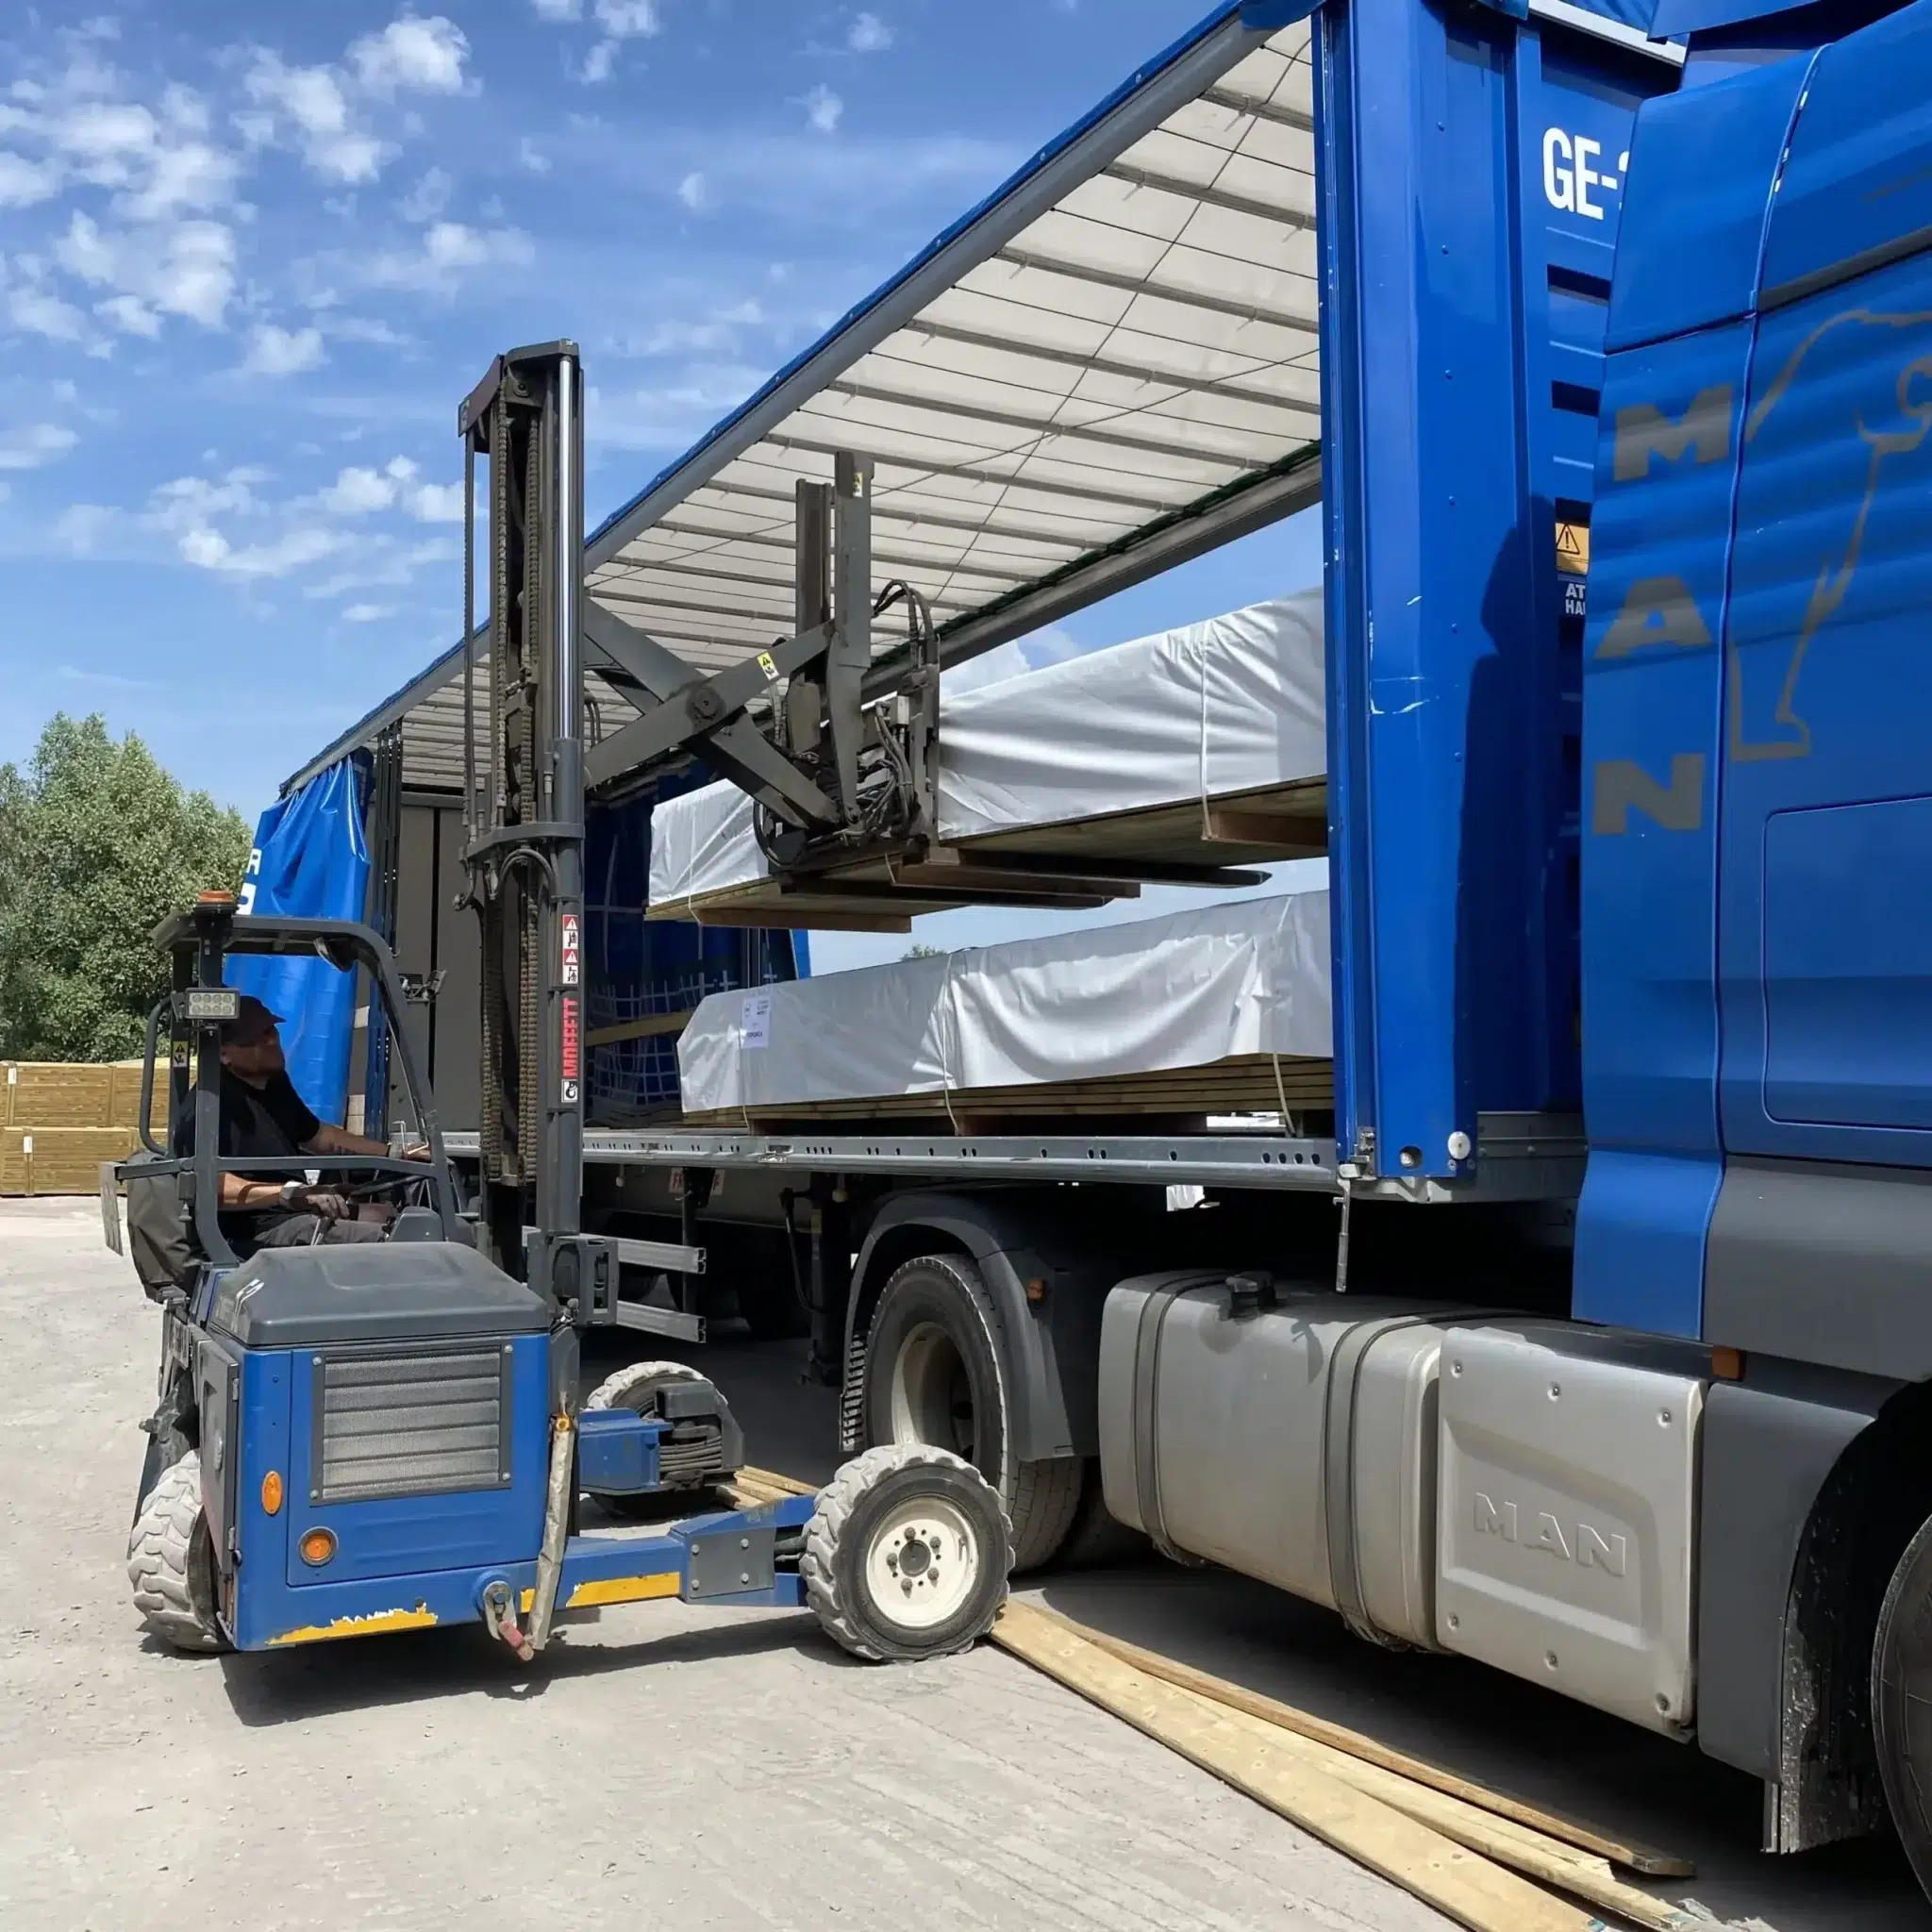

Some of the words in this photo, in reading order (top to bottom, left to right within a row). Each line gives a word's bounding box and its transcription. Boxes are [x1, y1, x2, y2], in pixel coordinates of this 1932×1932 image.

[1543, 127, 1630, 220] GE-
[1592, 384, 1732, 835] MAN
[562, 998, 578, 1077] MOFFETT
[1474, 1491, 1625, 1577] MAN
